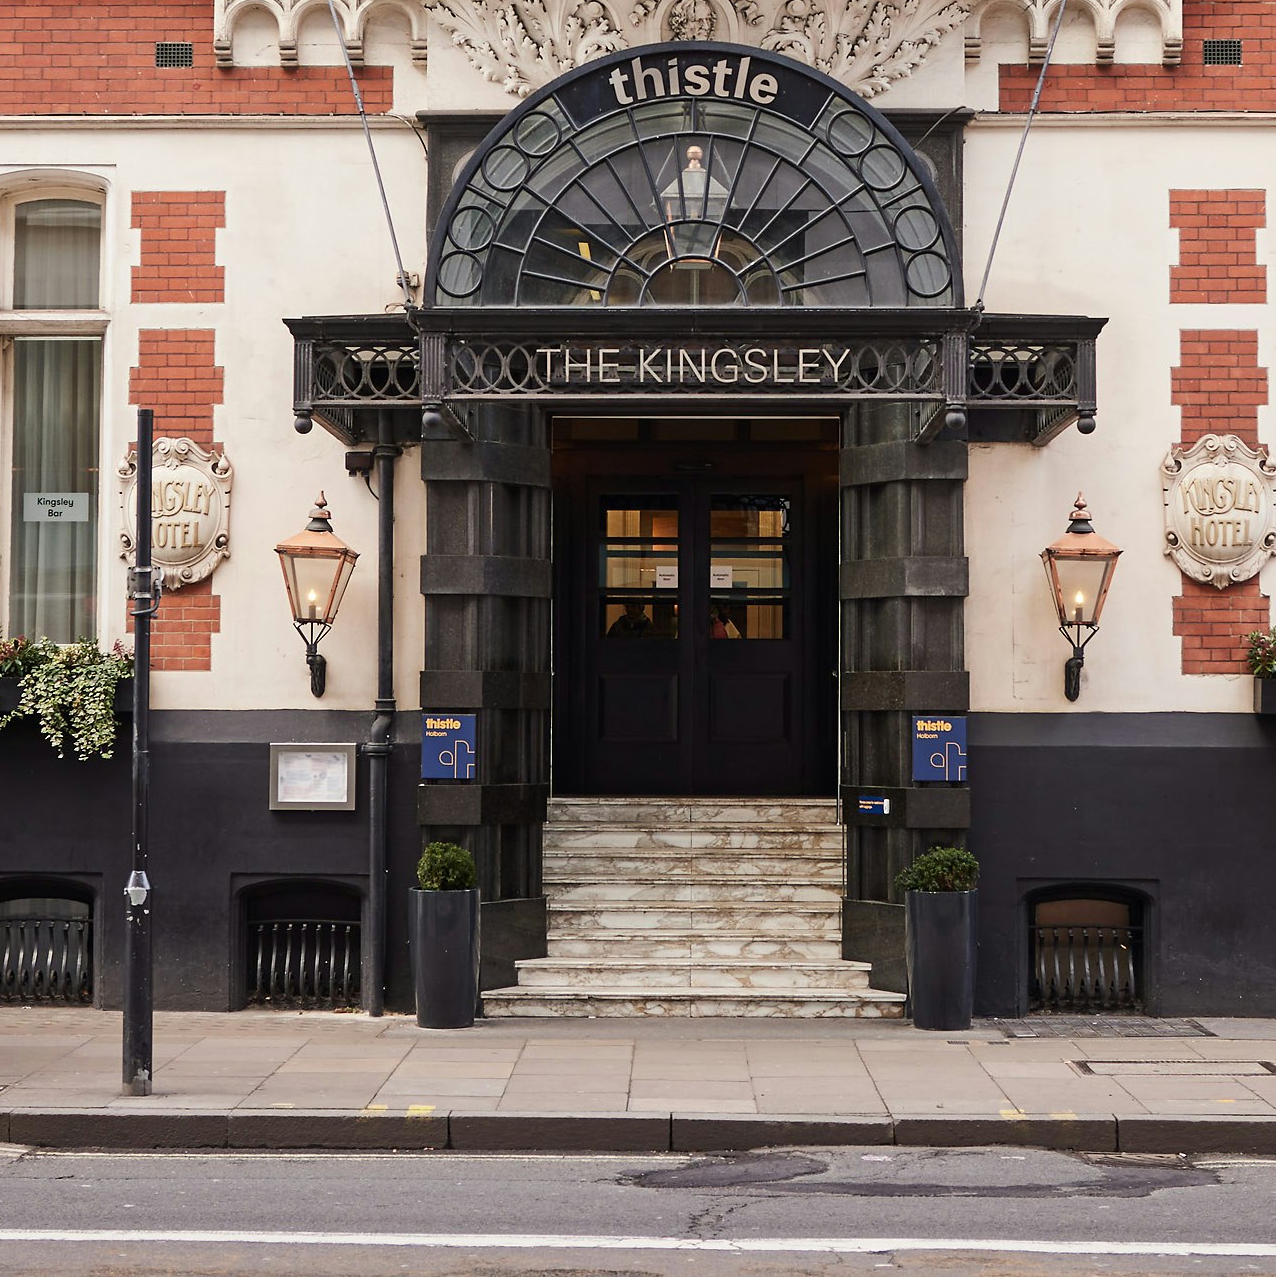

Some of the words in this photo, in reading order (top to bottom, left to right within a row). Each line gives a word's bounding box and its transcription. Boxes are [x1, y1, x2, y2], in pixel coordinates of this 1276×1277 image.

[608, 56, 779, 105] thistle
[536, 348, 621, 383] THE
[639, 348, 850, 383] KINGSLEY
[37, 497, 74, 508] Kingsley
[151, 480, 216, 518] NGSLEY
[1179, 478, 1264, 516] KINGSLEY
[47, 509, 63, 517] Bar
[150, 521, 205, 548] OTEL
[1190, 517, 1253, 546] HOTEL
[425, 718, 461, 730] thistle
[916, 720, 953, 732] thistle
